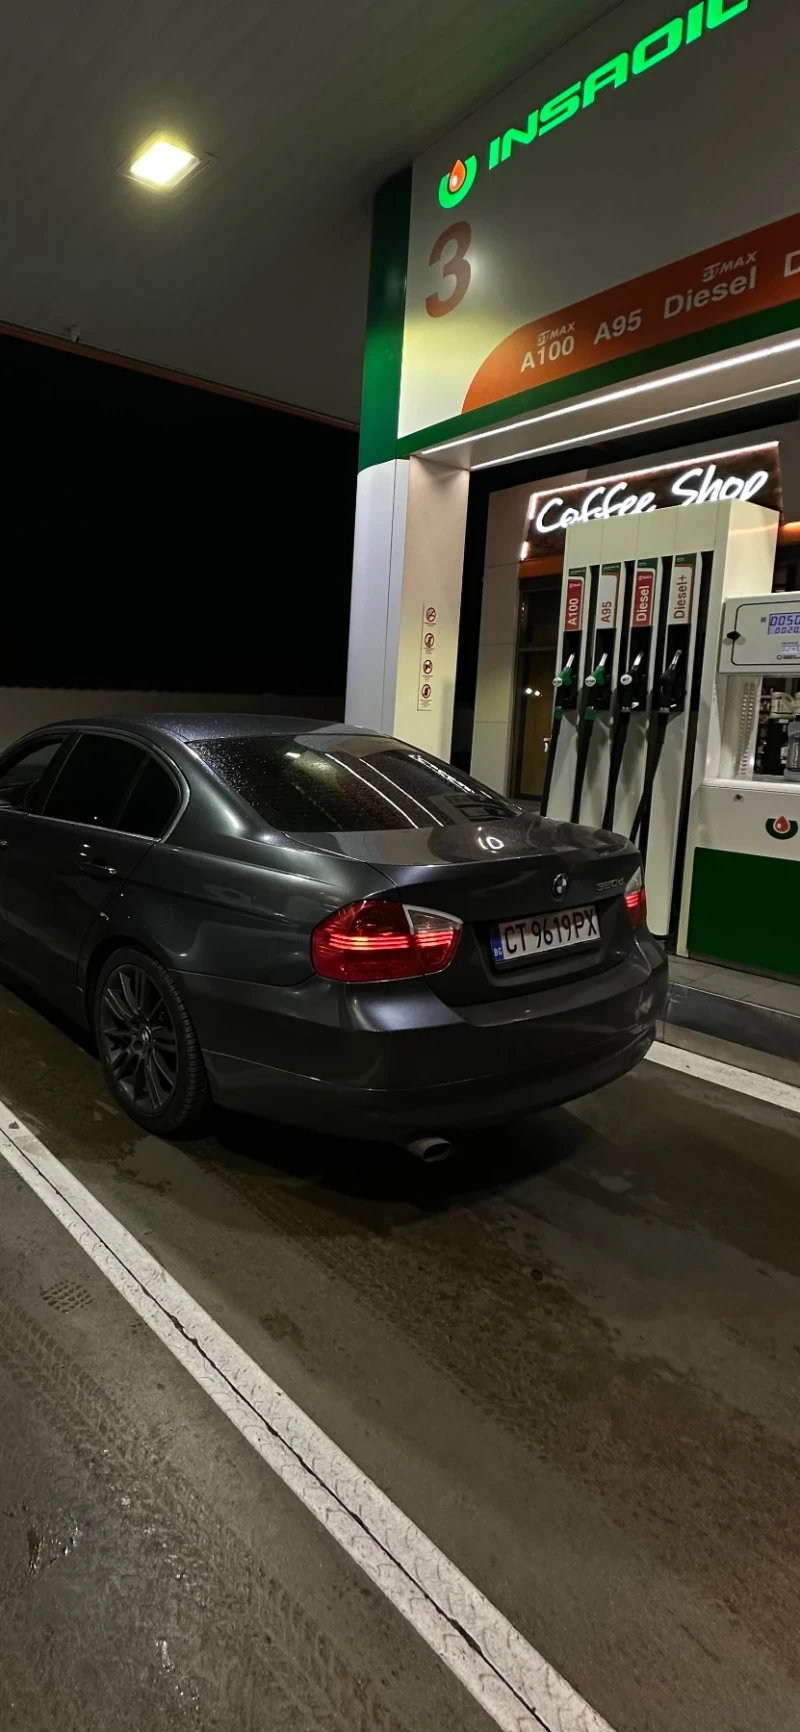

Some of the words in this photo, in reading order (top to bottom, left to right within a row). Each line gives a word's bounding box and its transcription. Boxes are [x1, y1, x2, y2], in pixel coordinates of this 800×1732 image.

[489, 0, 749, 170] INSAOIL
[425, 220, 472, 318] 3
[663, 265, 757, 320] Diesel
[593, 308, 642, 345] A95
[519, 335, 575, 373] A100
[535, 481, 657, 533] Coffee
[671, 464, 769, 505] Shop
[567, 597, 579, 626] A100
[601, 601, 612, 623] A95
[636, 585, 650, 622] Diesel
[673, 574, 688, 619] Diesel+
